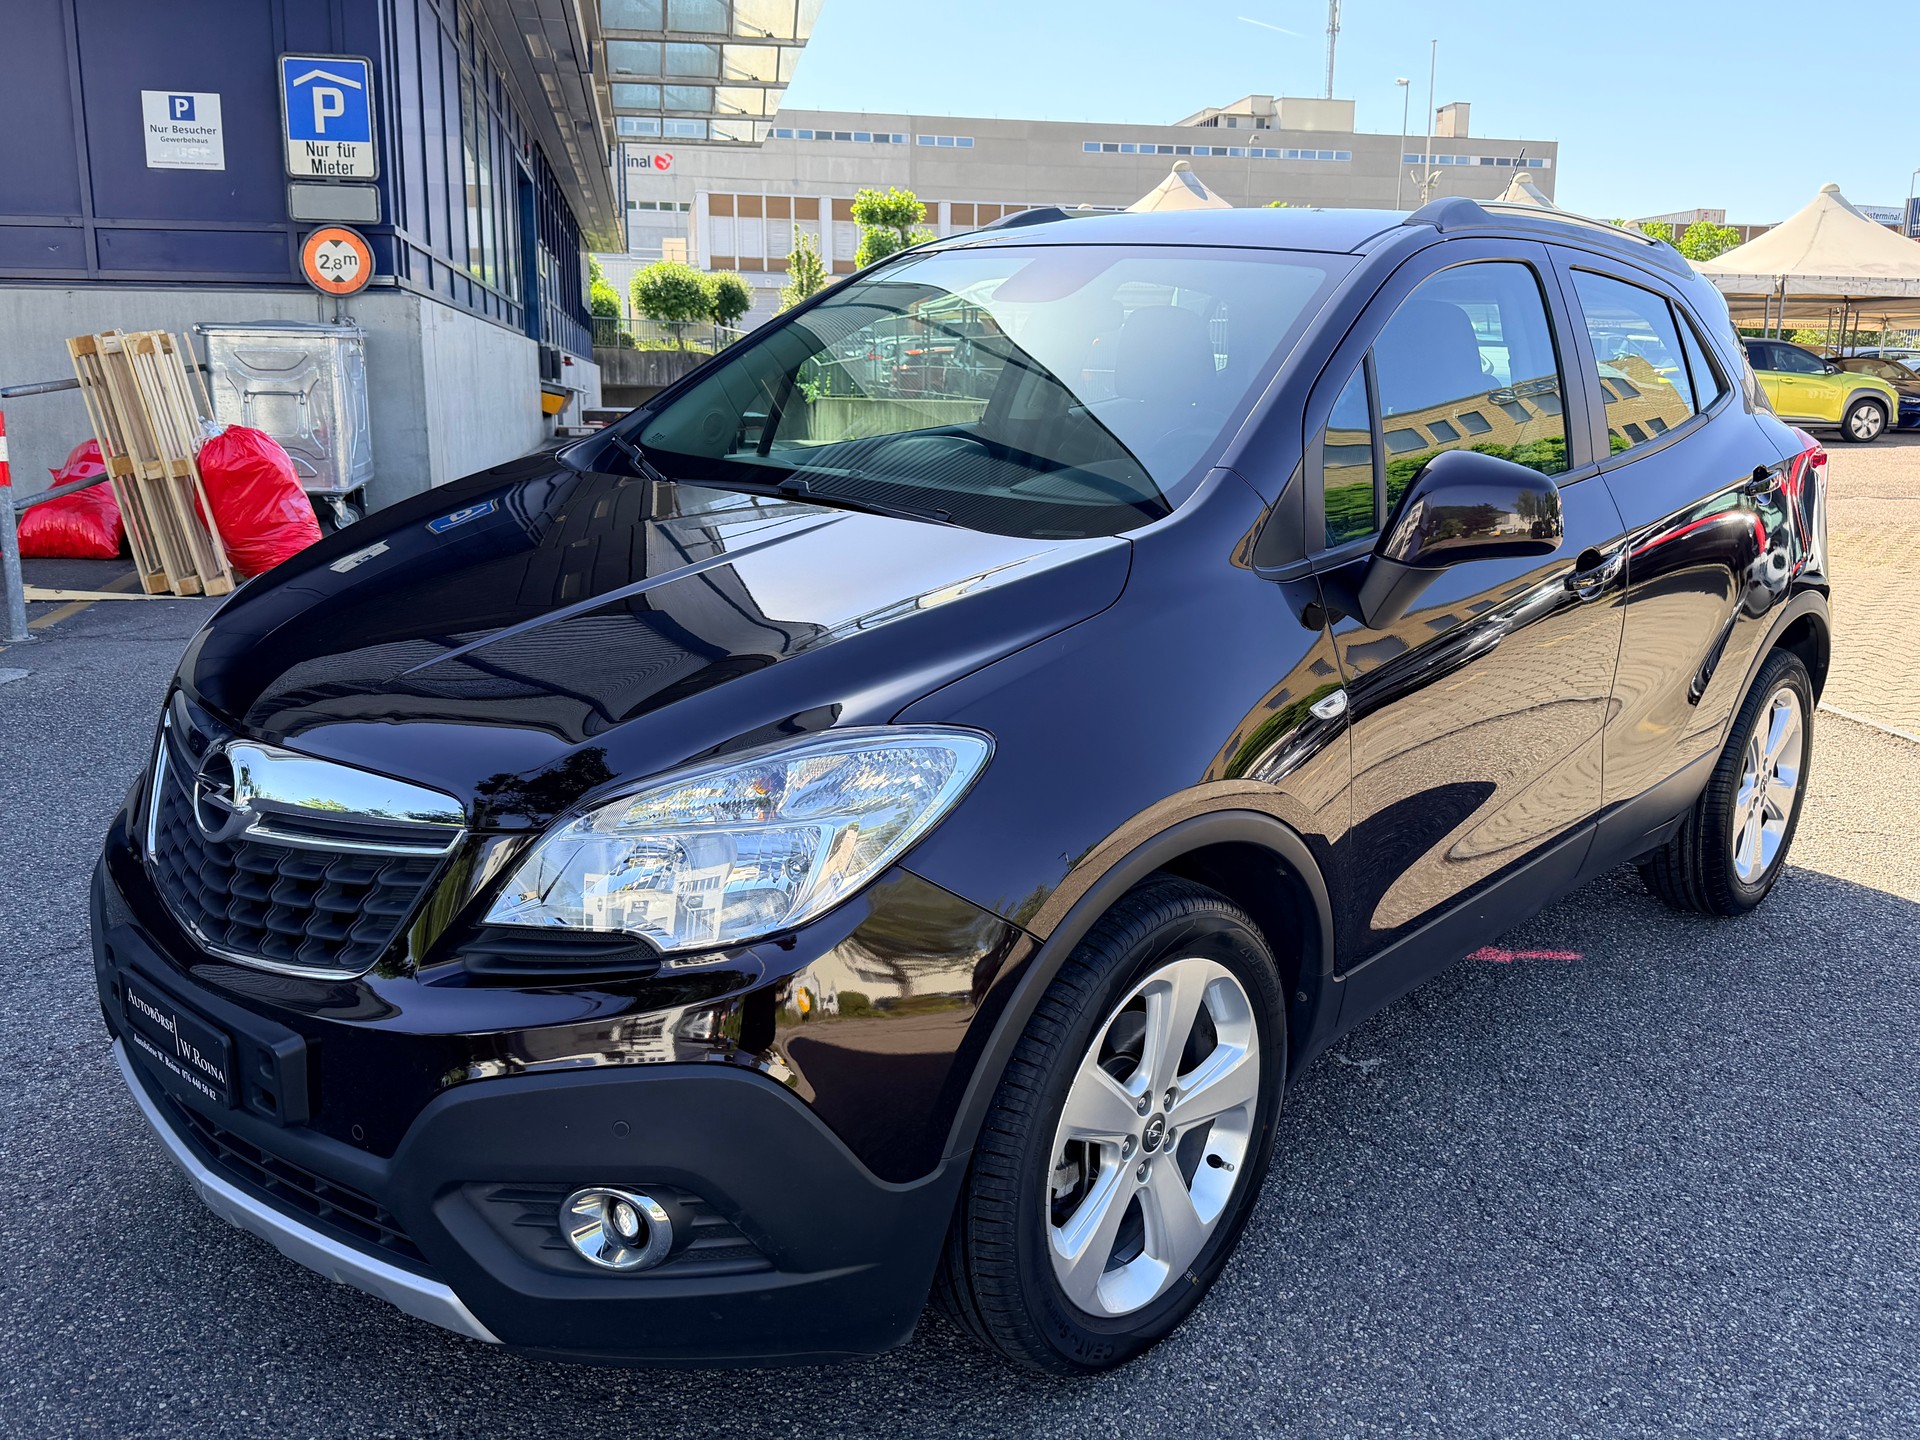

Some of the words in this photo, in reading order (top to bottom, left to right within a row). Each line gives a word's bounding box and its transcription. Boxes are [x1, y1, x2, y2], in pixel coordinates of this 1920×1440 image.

[175, 98, 189, 118] P
[312, 86, 345, 134] P
[149, 124, 169, 133] Nur
[172, 125, 217, 135] Besucher
[160, 136, 209, 144] Gewerbehaus
[306, 141, 329, 158] Nur
[336, 142, 357, 158] für
[311, 158, 355, 175] Mieter
[127, 987, 174, 1033] AUTOBÖRSE
